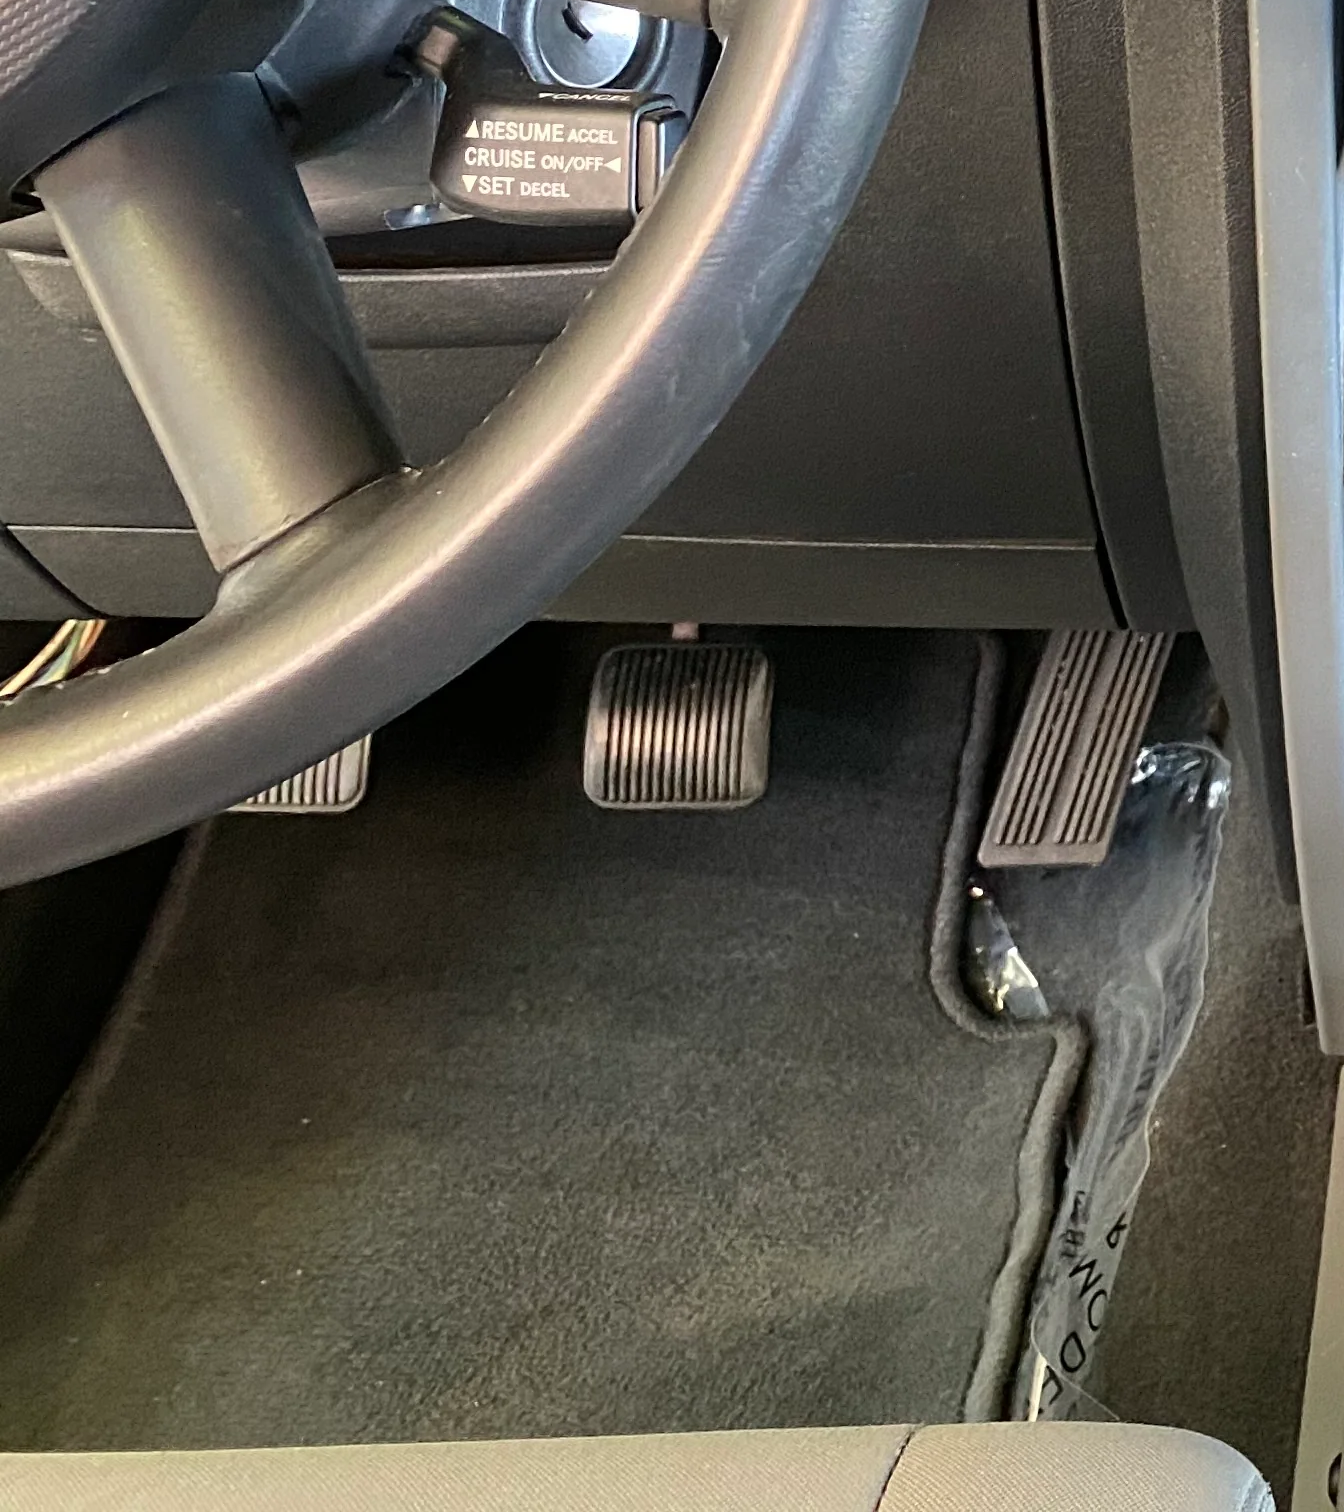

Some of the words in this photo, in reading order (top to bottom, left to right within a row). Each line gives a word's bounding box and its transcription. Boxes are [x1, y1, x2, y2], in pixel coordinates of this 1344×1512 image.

[552, 92, 632, 102] CANCEL
[482, 121, 564, 142] RESUME
[567, 129, 618, 144] ACCEL
[465, 147, 535, 168] CRUISE
[541, 153, 603, 173] ON/OFF
[479, 175, 514, 195] SET
[520, 182, 570, 197] DECEL
